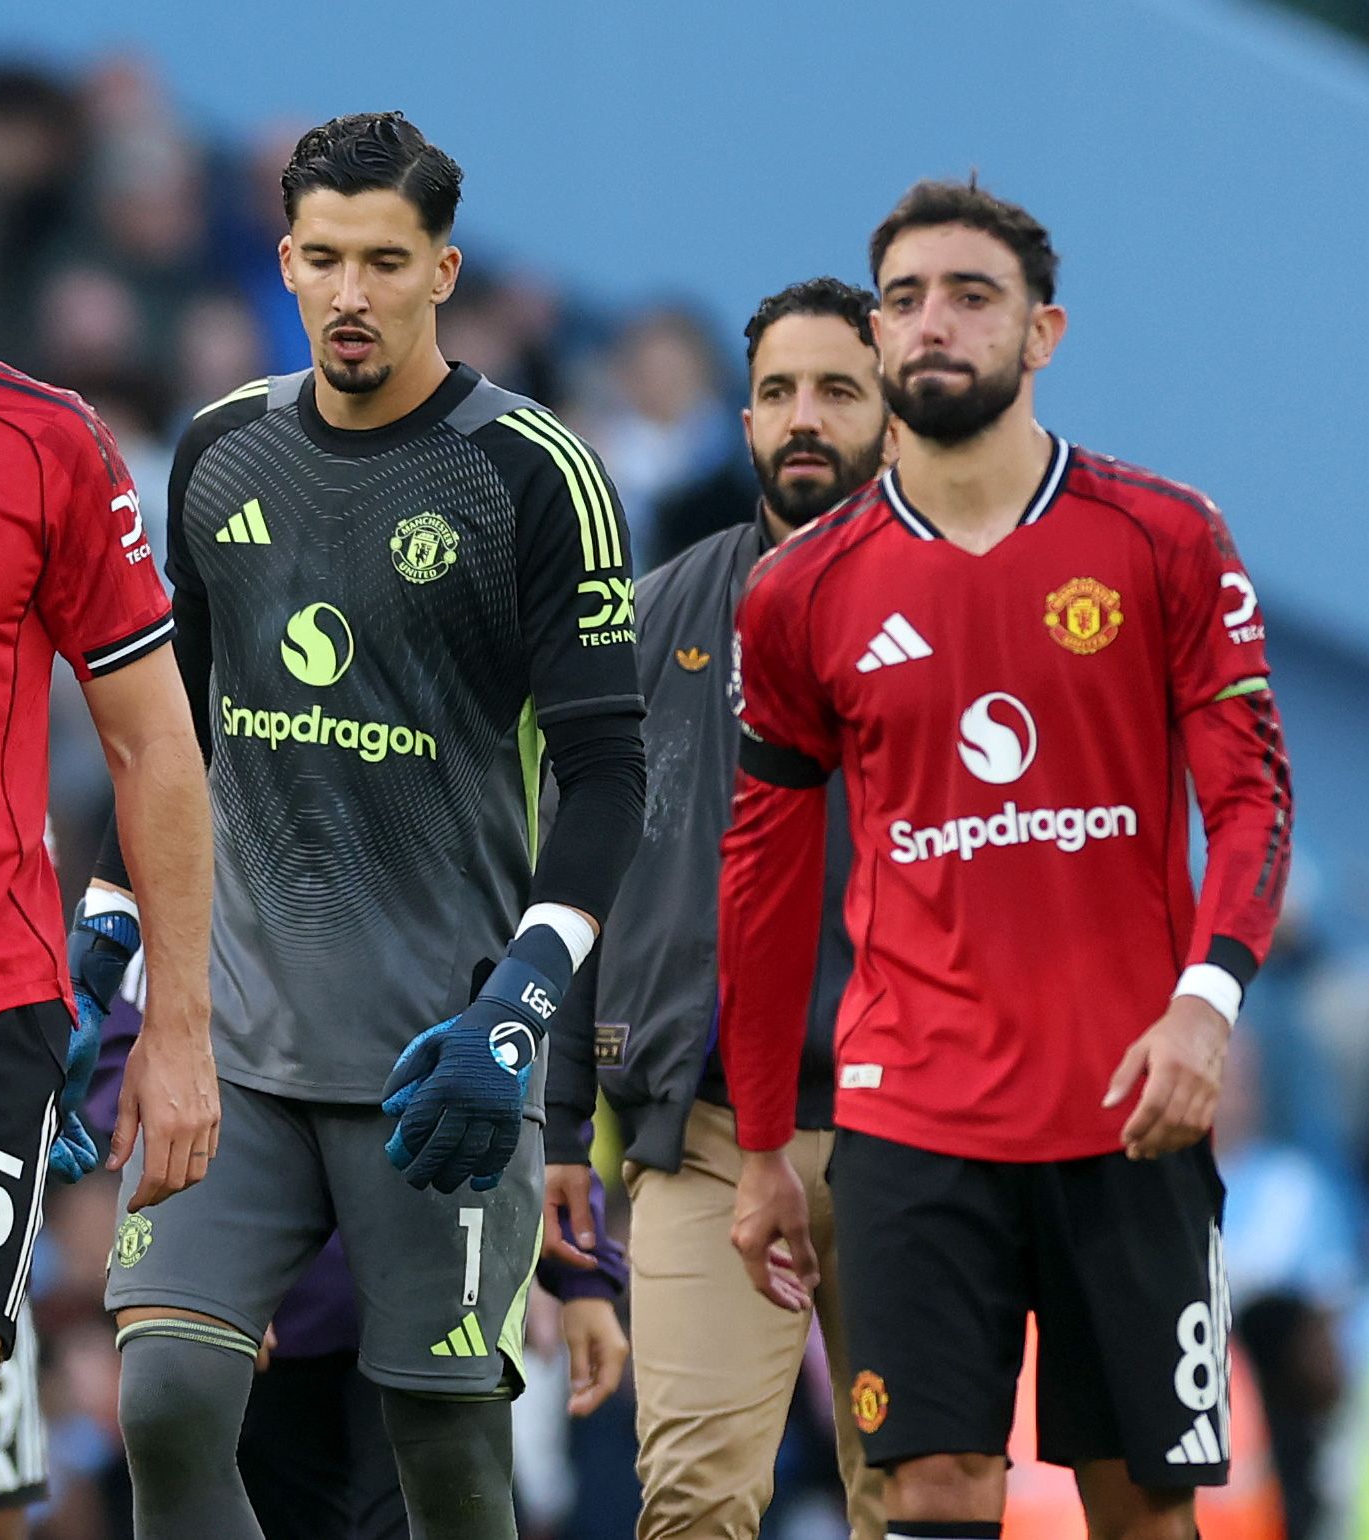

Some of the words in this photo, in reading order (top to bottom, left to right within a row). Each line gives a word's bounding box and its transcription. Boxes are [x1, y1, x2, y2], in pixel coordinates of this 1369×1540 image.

[400, 517, 454, 546] MANCHESTER
[398, 562, 438, 579] UNITED
[222, 696, 437, 762] Snapdragon
[890, 801, 1138, 863] Snapdragon
[459, 1207, 484, 1306] 1
[1174, 1301, 1218, 1411] 8
